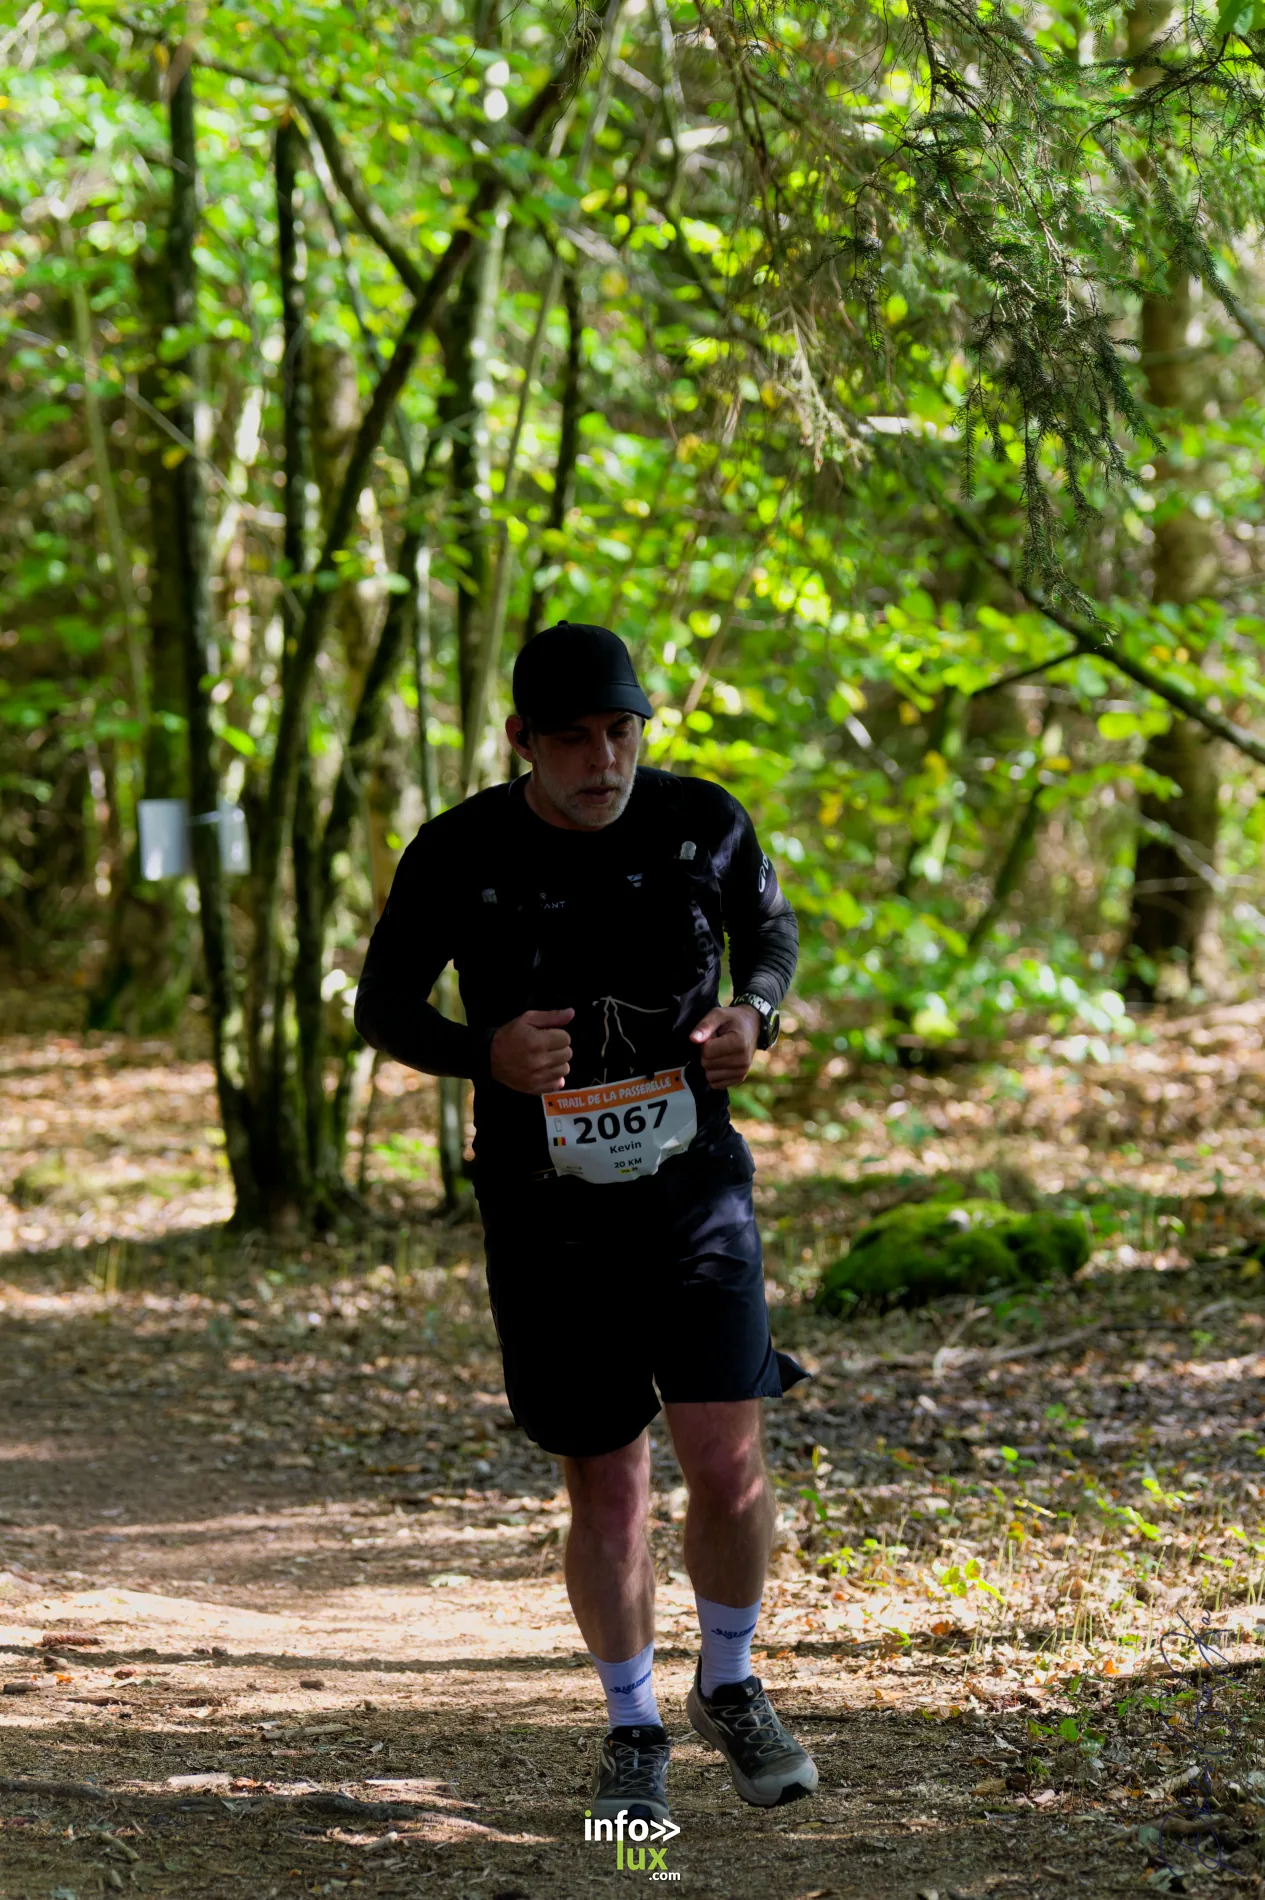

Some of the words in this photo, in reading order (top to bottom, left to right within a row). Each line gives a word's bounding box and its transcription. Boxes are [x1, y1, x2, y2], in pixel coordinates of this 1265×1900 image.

[556, 1097, 585, 1109] TRAIL
[588, 1094, 600, 1105] DE
[603, 1088, 617, 1101] LA
[618, 1077, 672, 1099] PASSERELLE
[573, 1099, 668, 1145] 2067
[609, 1140, 642, 1154] Kevin
[613, 1161, 626, 1169] 20
[628, 1157, 642, 1166] KM
